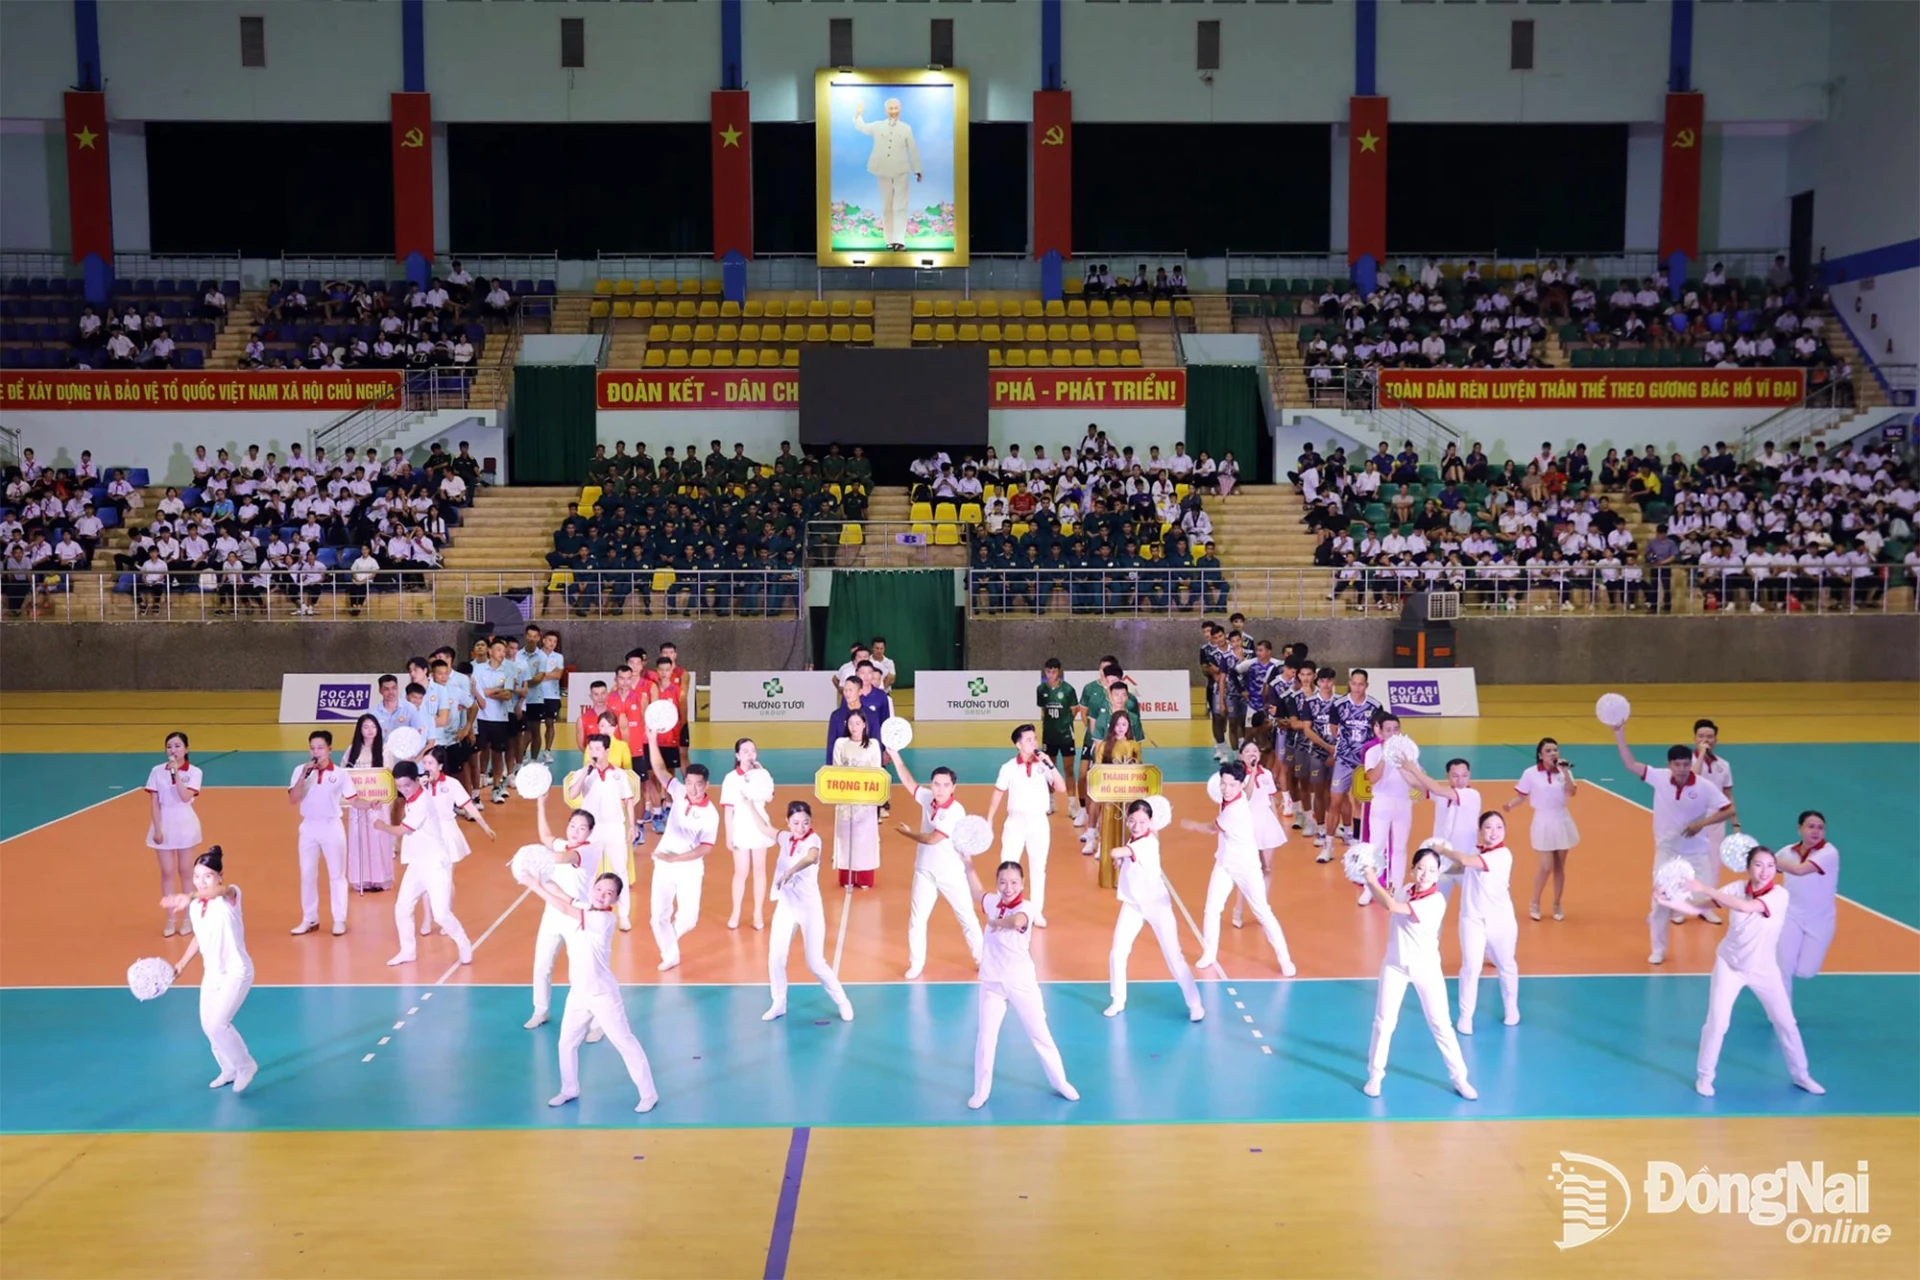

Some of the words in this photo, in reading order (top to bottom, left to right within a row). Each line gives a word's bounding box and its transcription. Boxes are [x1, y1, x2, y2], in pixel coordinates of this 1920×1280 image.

[7, 377, 25, 400] ĐỂ
[28, 380, 52, 400] XÂY
[56, 382, 92, 404] DỰNG
[94, 380, 112, 400] VÀ
[114, 378, 140, 400] BẢO
[143, 380, 160, 404] VỆ
[162, 377, 178, 400] TỔ
[181, 378, 216, 402] QUỐC
[218, 380, 245, 404] VIỆT
[248, 384, 278, 400] NAM
[282, 380, 299, 400] XÃ
[302, 380, 323, 404] HỘI
[327, 378, 352, 400] CHỦ
[356, 380, 395, 400] NGHĨA
[607, 378, 663, 402] ĐOÀN
[668, 376, 705, 402] KẾT
[725, 378, 766, 402] DÂN
[772, 382, 799, 402] CH
[996, 377, 1036, 401] PHÁ
[1055, 377, 1106, 401] PHÁT
[1112, 373, 1176, 401] TRIỂN!
[1385, 379, 1423, 399] TOÀN
[1427, 379, 1456, 399] DÂN
[1460, 379, 1488, 399] RÈN
[1492, 379, 1536, 402] LUYỆN
[1540, 379, 1577, 399] THÂN
[1581, 375, 1608, 399] THỂ
[1610, 382, 1645, 399] THEO
[1649, 380, 1697, 398] GƯƠNG
[1701, 378, 1729, 398] BÁC
[1773, 381, 1797, 401] ĐẠI
[1886, 428, 1903, 436] WC
[320, 690, 369, 699] POCARI
[1390, 686, 1438, 695] POCARI
[319, 699, 364, 707] SWEAT
[1391, 695, 1434, 703] SWEAT
[1138, 701, 1152, 712] NG
[1154, 701, 1179, 712] REAL
[1048, 708, 1059, 719] 40
[1351, 729, 1362, 742] 15
[826, 779, 860, 793] TRỌNG
[863, 780, 879, 792] TÀI
